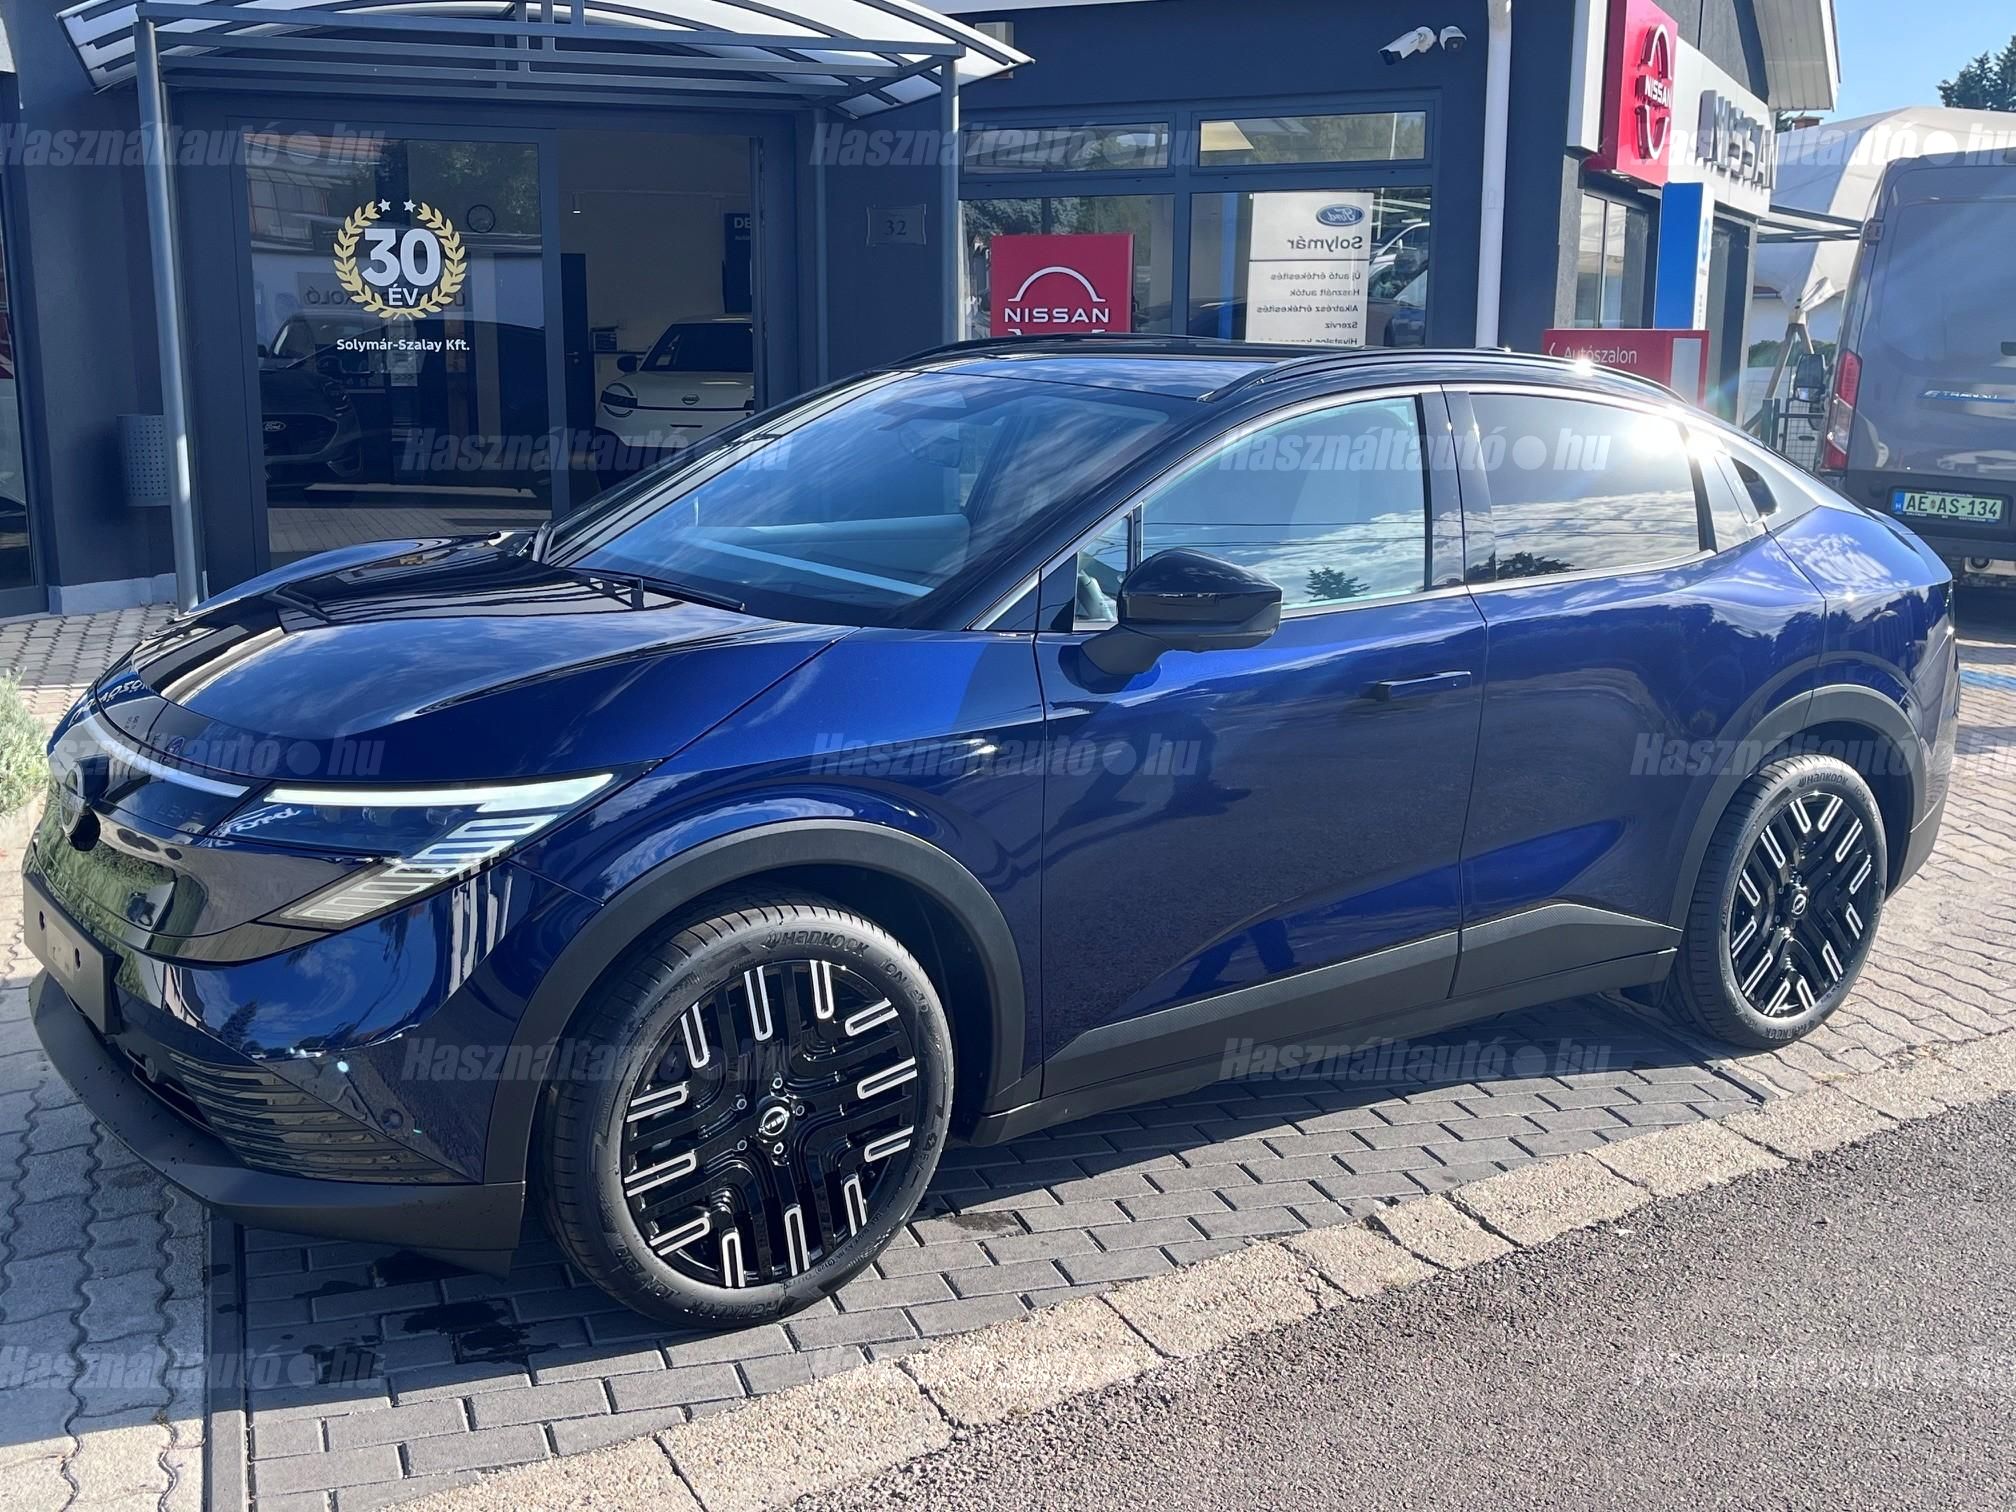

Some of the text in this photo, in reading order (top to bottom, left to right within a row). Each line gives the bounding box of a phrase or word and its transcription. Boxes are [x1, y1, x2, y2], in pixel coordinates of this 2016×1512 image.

[1644, 74, 1672, 107] NISSAN
[885, 220, 906, 236] 32
[361, 228, 441, 287] 30
[388, 283, 419, 306] ÉV
[1004, 307, 1110, 323] NISSAN
[336, 339, 470, 352] Solymár-Szalay Kft.
[1906, 495, 1929, 511] AE
